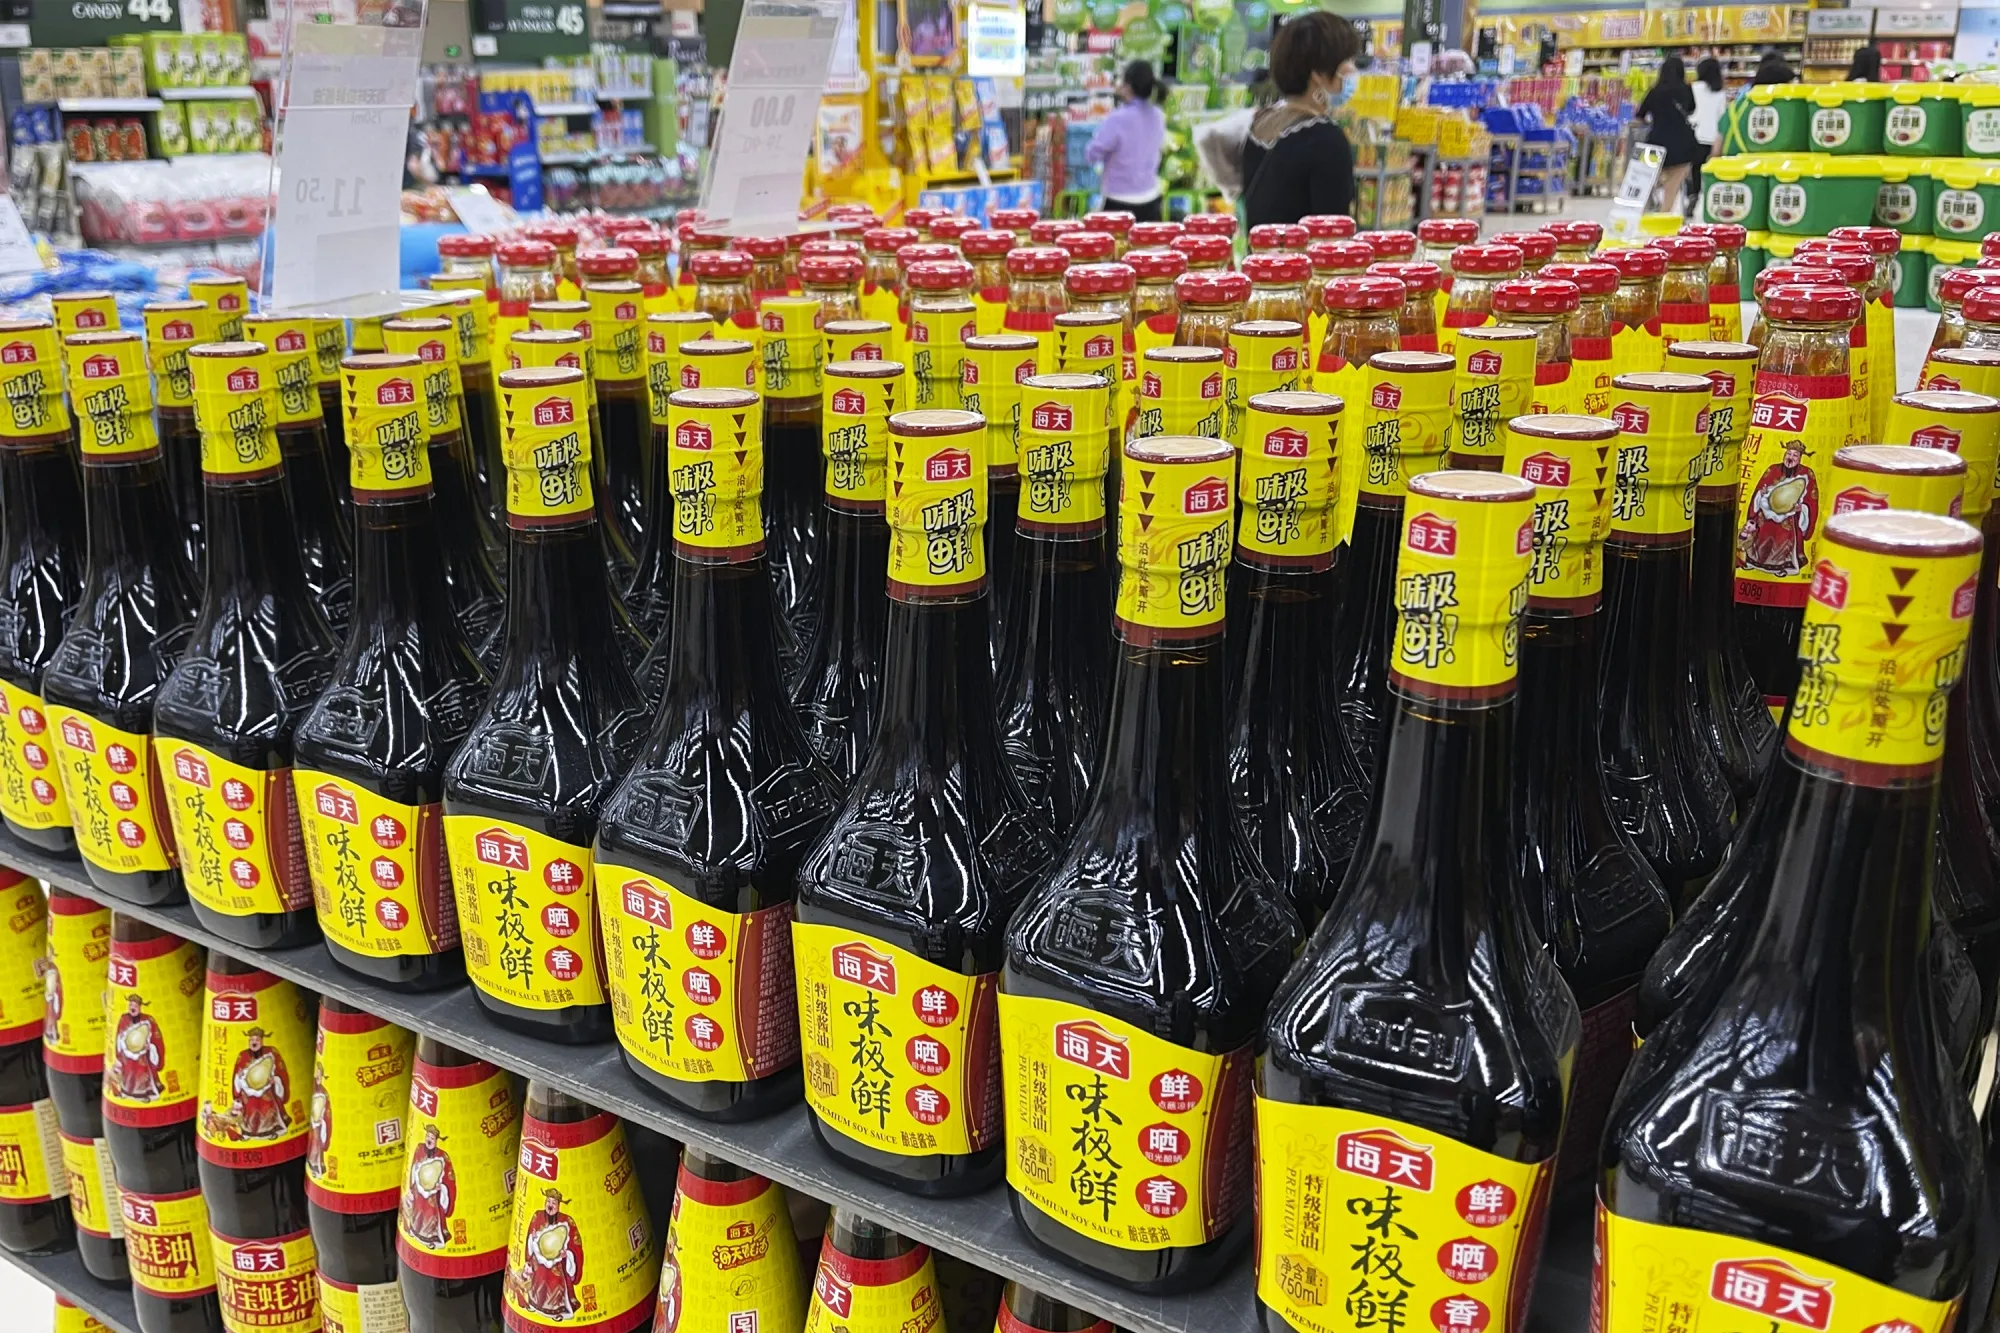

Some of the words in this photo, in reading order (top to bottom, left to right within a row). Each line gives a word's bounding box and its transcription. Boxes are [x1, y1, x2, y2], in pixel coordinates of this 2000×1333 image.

[128, 0, 173, 22] 44
[557, 6, 584, 35] 45
[421, 348, 443, 361] 海天
[1087, 341, 1112, 357] 海天
[1275, 354, 1297, 369] 海天
[87, 361, 117, 377] 海天
[1470, 356, 1498, 374] 海天
[231, 374, 257, 390] 海天
[381, 386, 411, 402] 海天
[835, 395, 862, 413] 海天
[1373, 389, 1399, 409] 海天
[1461, 384, 1500, 416] 味极
[538, 404, 571, 422] 海天
[1035, 411, 1068, 430] 海天
[1614, 412, 1644, 431] 海天
[1751, 402, 1801, 429] 海天
[376, 411, 421, 446] 味极
[677, 430, 708, 448] 海天
[829, 424, 866, 452] 味极
[1367, 420, 1400, 451] 味极
[534, 433, 581, 469] 味极
[1268, 436, 1304, 455] 海天
[930, 457, 970, 478] 海天
[1028, 441, 1074, 476] 味极
[673, 461, 716, 495] 味极
[1526, 461, 1566, 484] 海天
[1257, 469, 1308, 506] 味极
[922, 489, 976, 530] 味极
[1189, 489, 1227, 512] 海天
[1177, 520, 1229, 569] 味极
[1411, 525, 1452, 552] 海天
[1400, 571, 1457, 612] 味极
[1739, 582, 1762, 599] 908g
[20, 709, 38, 726] 鲜
[63, 724, 92, 749] 海天
[109, 748, 129, 765] 鲜
[176, 757, 207, 784] 海天
[33, 780, 49, 797] 香
[112, 784, 131, 802] 晒
[225, 782, 246, 801] 鲜
[76, 752, 113, 856] 味极鲜
[319, 792, 355, 821] 海天
[120, 821, 138, 839] 香
[226, 822, 247, 840] 晒
[376, 818, 397, 839] 鲜
[186, 788, 223, 896] 味极鲜
[481, 837, 524, 868] 海天
[234, 861, 253, 880] 香
[327, 824, 368, 938] 味极鲜
[376, 861, 396, 880] 晒
[550, 863, 573, 884] 鲜
[463, 867, 480, 925] 特级酱油
[626, 889, 668, 925] 海天
[380, 901, 400, 921] 香
[548, 908, 569, 928] 晒
[488, 870, 534, 990] 味极鲜
[691, 925, 716, 949] 鲜
[551, 950, 573, 970] 香
[838, 951, 889, 990] 海天
[502, 987, 517, 997] SOY
[518, 990, 541, 1002] SAUCE
[632, 926, 674, 1056] 味极鲜
[689, 972, 711, 995] 晒
[214, 1001, 252, 1019] 海天
[920, 989, 947, 1015] 鲜
[815, 981, 831, 1049] 特级酱油
[691, 1018, 714, 1040] 香
[645, 1050, 659, 1062] SOY
[658, 1056, 680, 1070] SAUCE
[843, 990, 894, 1130] 味极鲜
[913, 1040, 939, 1065] 晒
[1062, 1029, 1122, 1075] 海天
[1032, 1061, 1048, 1134] 特级酱油
[1160, 1073, 1191, 1101] 鲜
[914, 1088, 939, 1113] 香
[813, 1100, 851, 1129] PREMIUM
[852, 1123, 870, 1136] SOY
[870, 1130, 898, 1145] SAUCE
[900, 1131, 938, 1149] 酿造酱油
[1065, 1074, 1123, 1223] 味极鲜
[1149, 1128, 1179, 1154] 晒
[1019, 1156, 1054, 1184] 750mL
[1346, 1139, 1426, 1186] 海天
[1146, 1180, 1176, 1206] 香
[1282, 1166, 1298, 1242] PREMIUM
[1468, 1184, 1504, 1214] 鲜
[1024, 1185, 1069, 1217] PREMIUM
[1070, 1212, 1090, 1228] SOY
[1091, 1221, 1124, 1239] SAUCE
[1300, 1173, 1322, 1252] 特级酱油
[730, 1224, 753, 1239] 海天
[1127, 1224, 1171, 1245] 酿造酱油
[236, 1252, 279, 1270] 海天
[1346, 1186, 1419, 1333] 味极鲜
[1451, 1242, 1487, 1272] 晒
[1280, 1273, 1324, 1306] 750mL
[1723, 1269, 1821, 1324] 海天
[1444, 1299, 1479, 1327] 香
